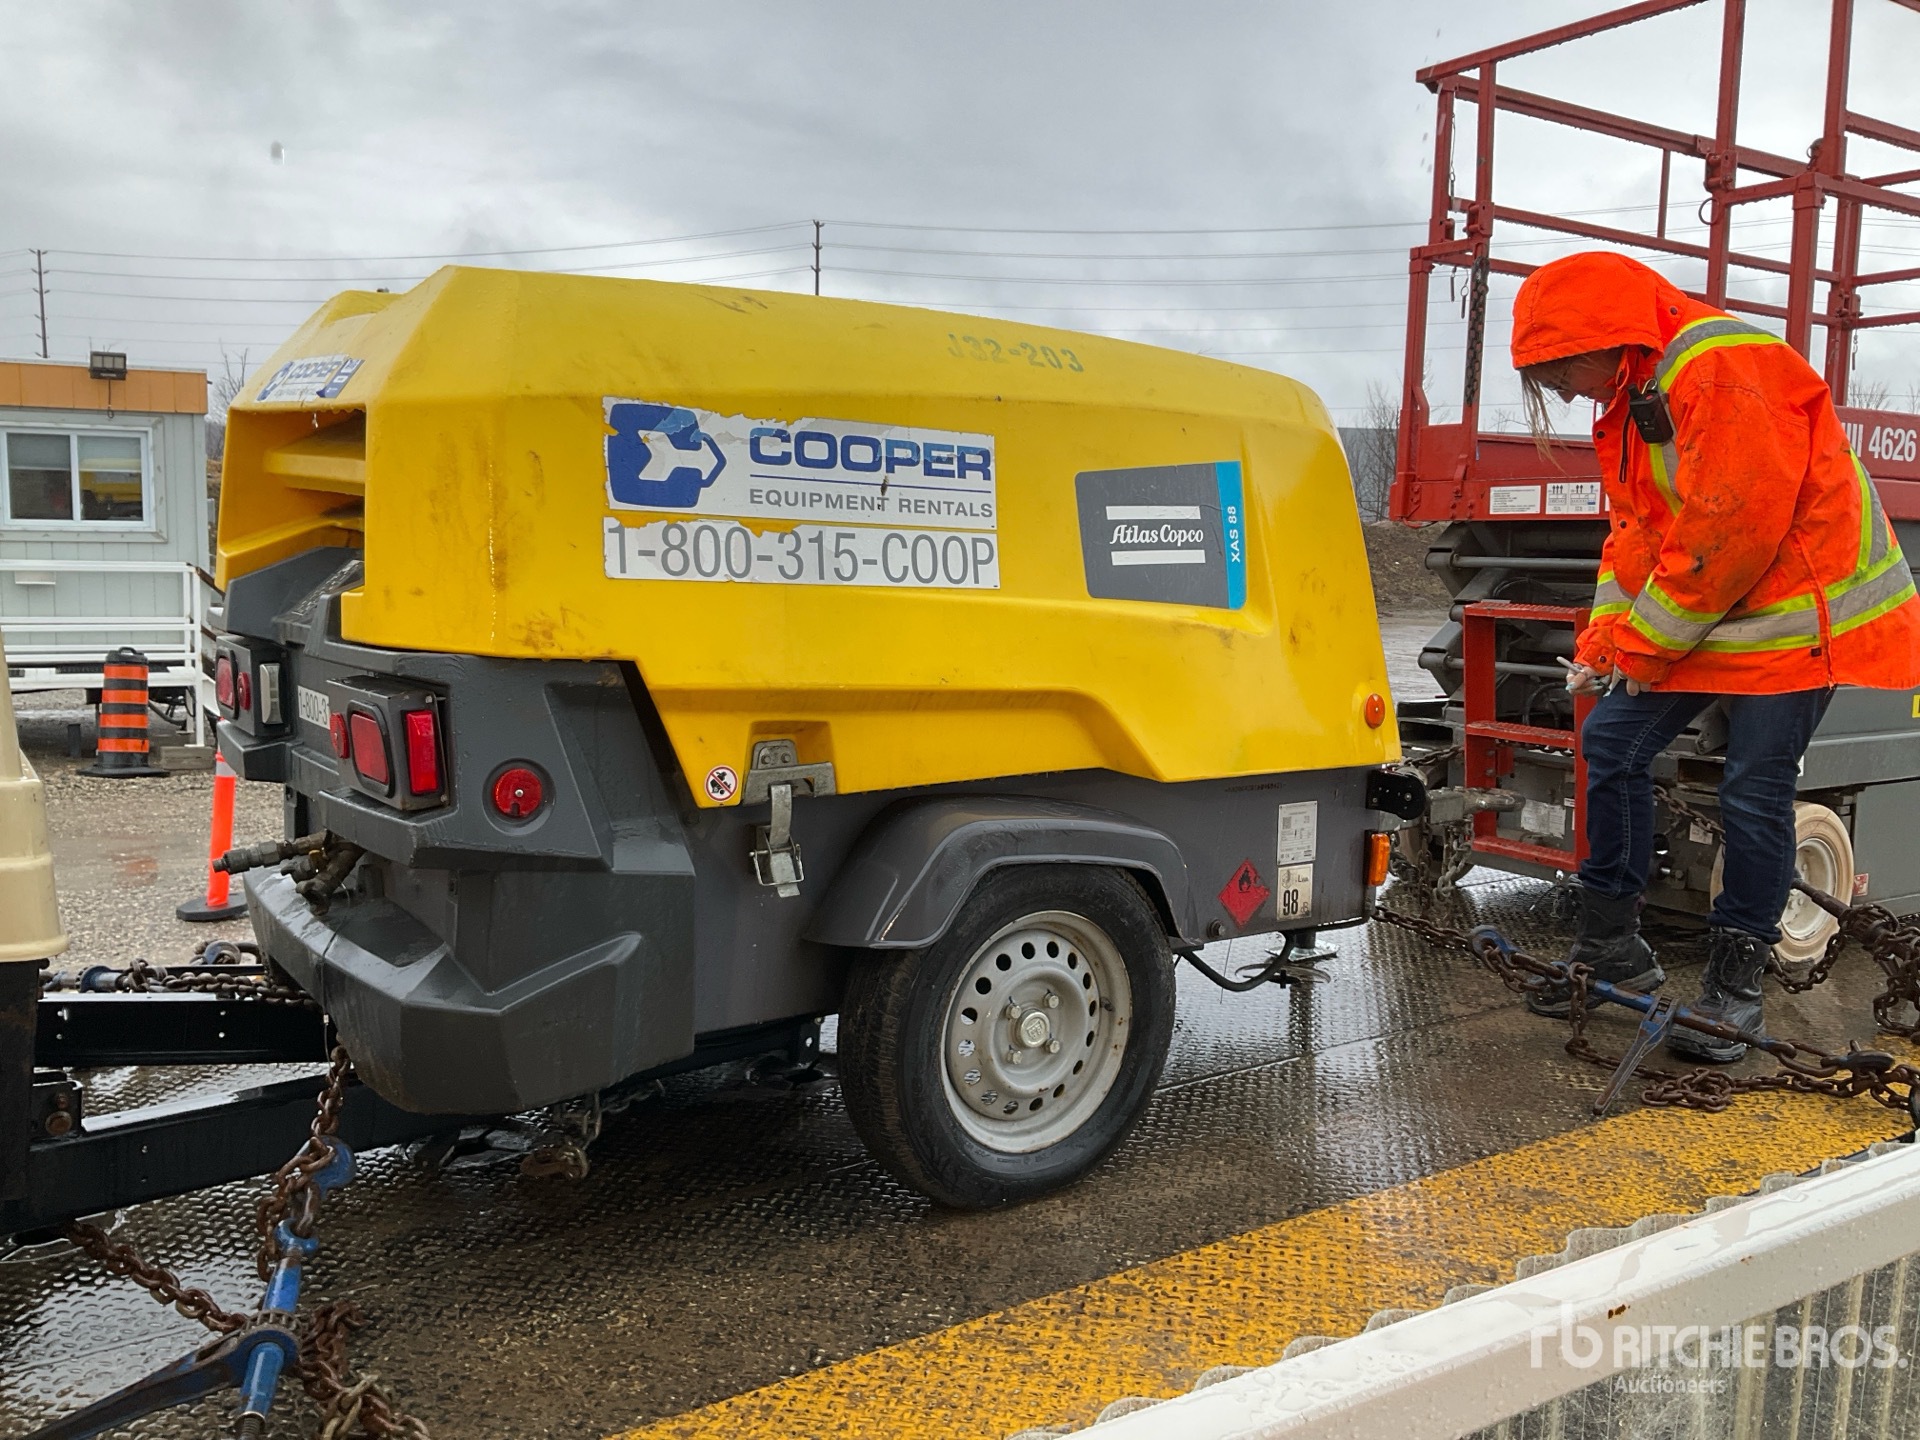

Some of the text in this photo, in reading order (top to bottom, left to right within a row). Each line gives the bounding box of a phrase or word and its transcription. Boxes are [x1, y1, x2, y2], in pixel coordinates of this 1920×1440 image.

[749, 427, 992, 481] COOPER
[1868, 426, 1918, 462] 4626
[749, 488, 993, 518] EQUIPMENT RENTALS
[1227, 505, 1241, 563] XAS 88
[607, 524, 994, 584] 1-800-315-COOP
[298, 689, 329, 725] 1-800-3
[1283, 888, 1299, 916] 98
